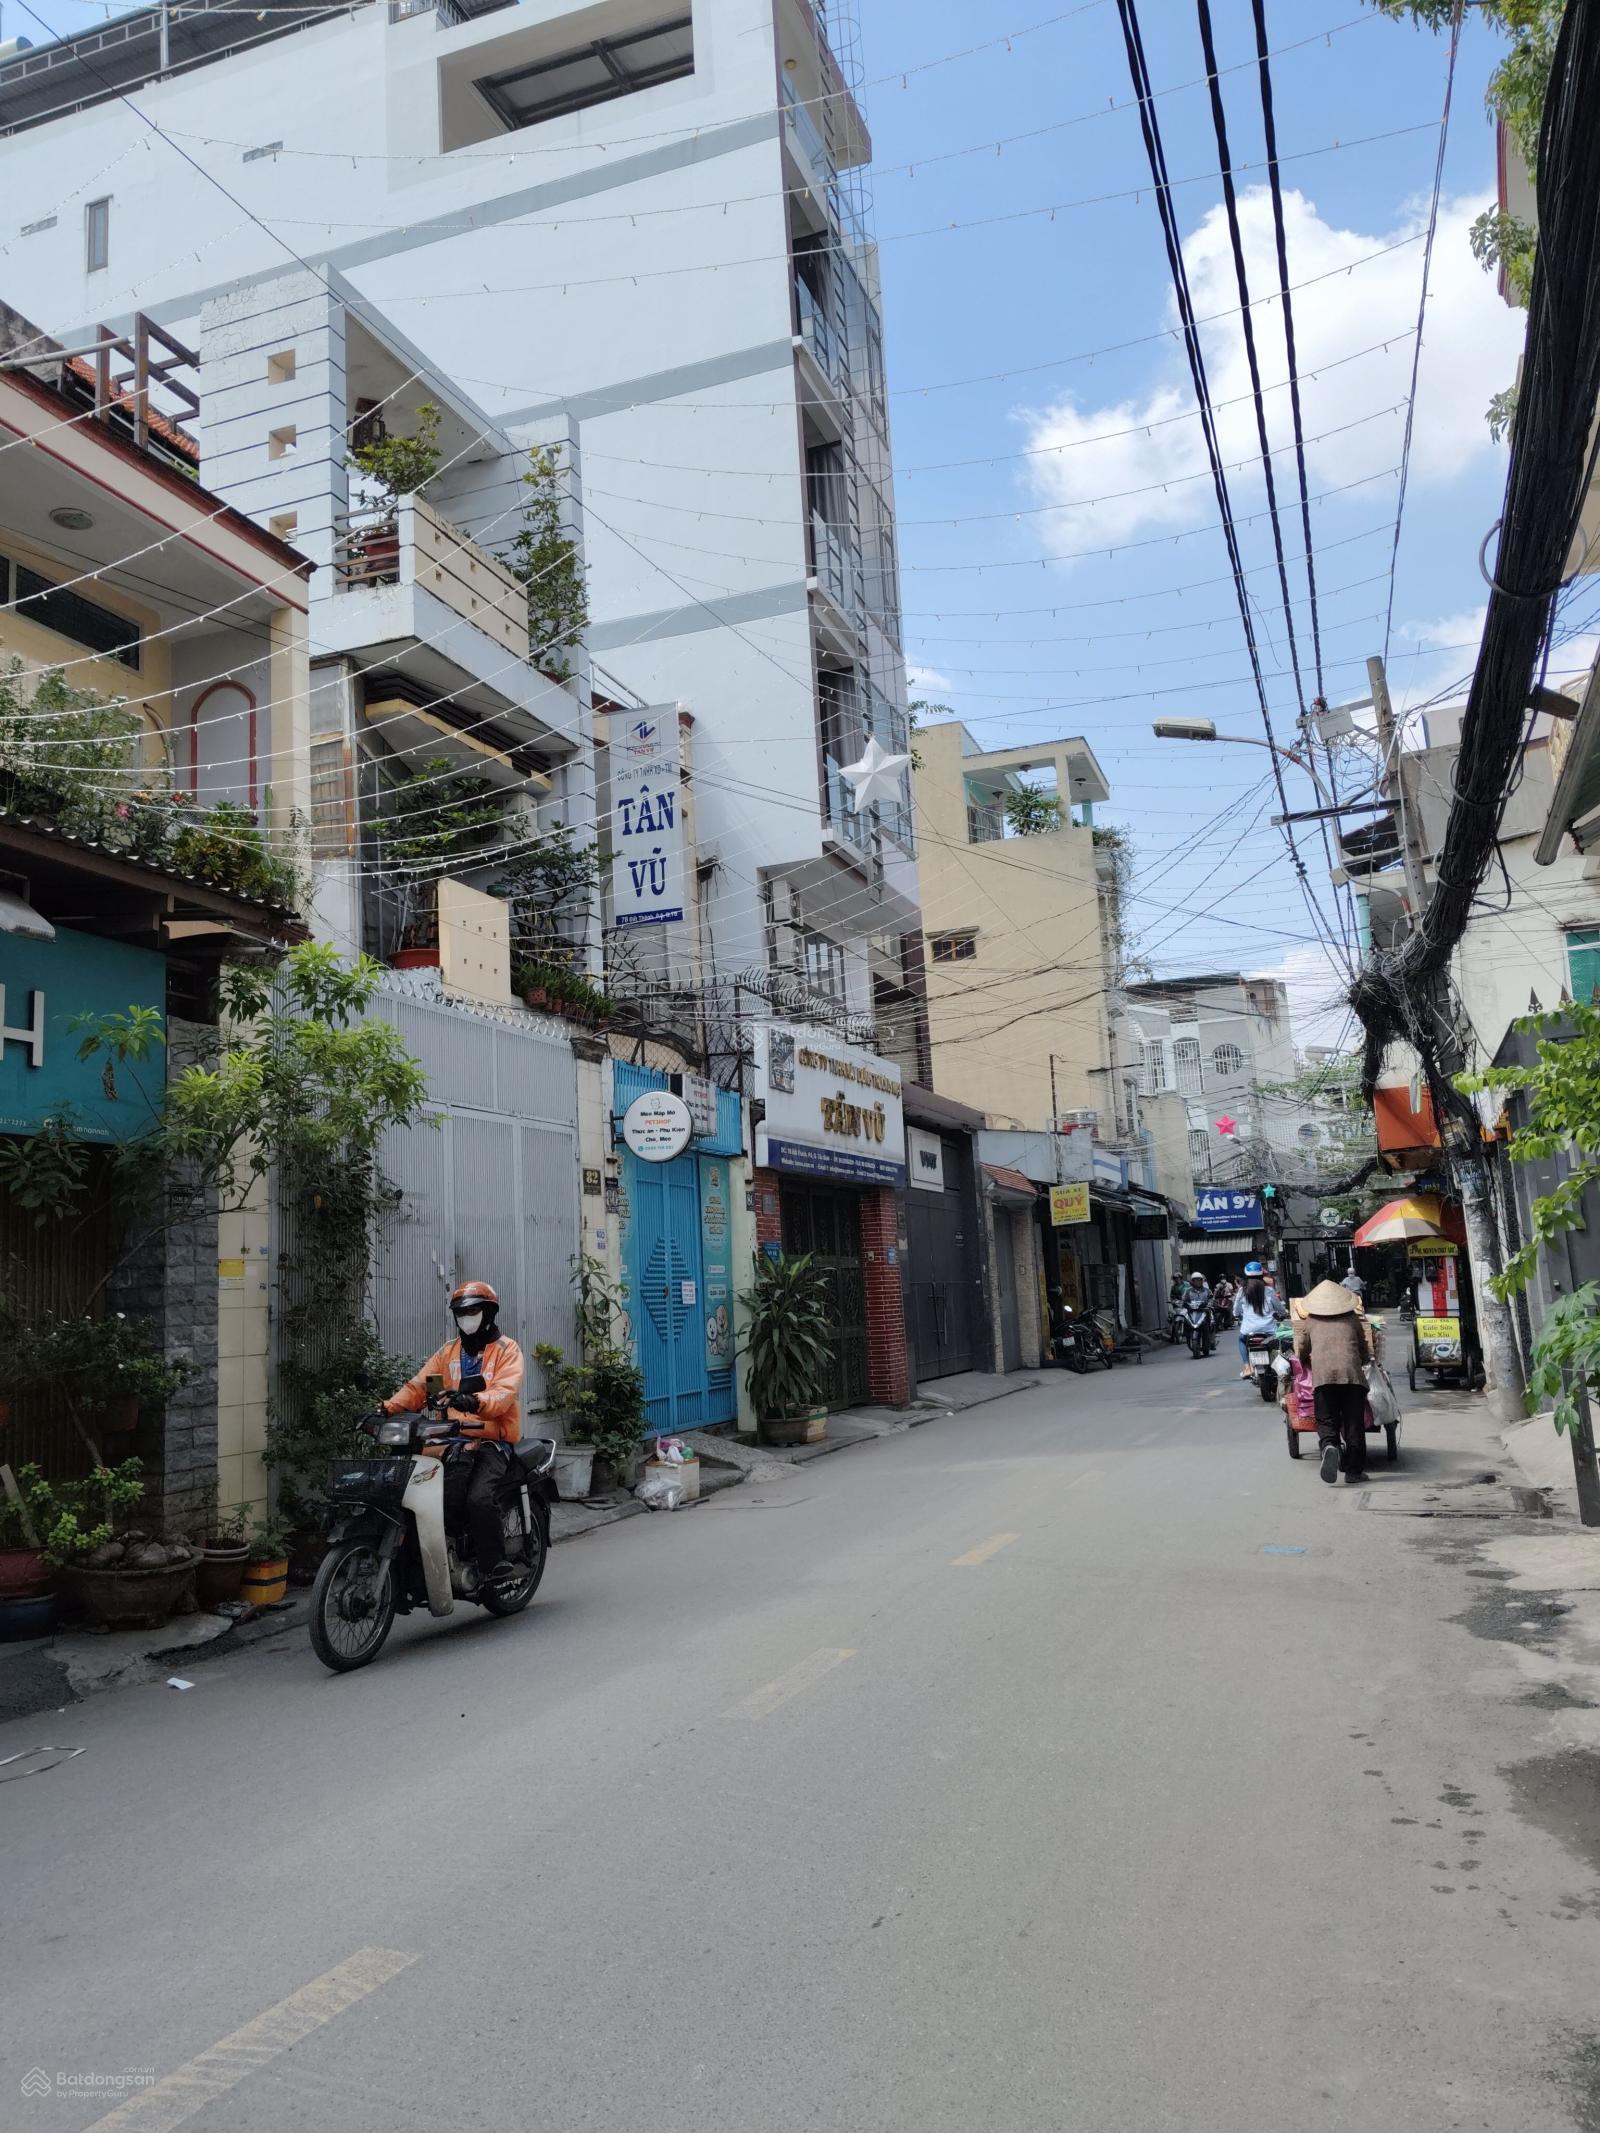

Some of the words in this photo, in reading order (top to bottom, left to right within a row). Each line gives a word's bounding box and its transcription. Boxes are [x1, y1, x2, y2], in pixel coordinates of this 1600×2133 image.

[618, 784, 675, 836] TÂN
[627, 847, 667, 898] VŨ
[821, 1090, 861, 1138] TÂN
[861, 1101, 886, 1142] VŨ
[586, 1170, 599, 1185] 82
[1053, 1194, 1084, 1210] QUÝ
[1232, 1194, 1256, 1209] 97
